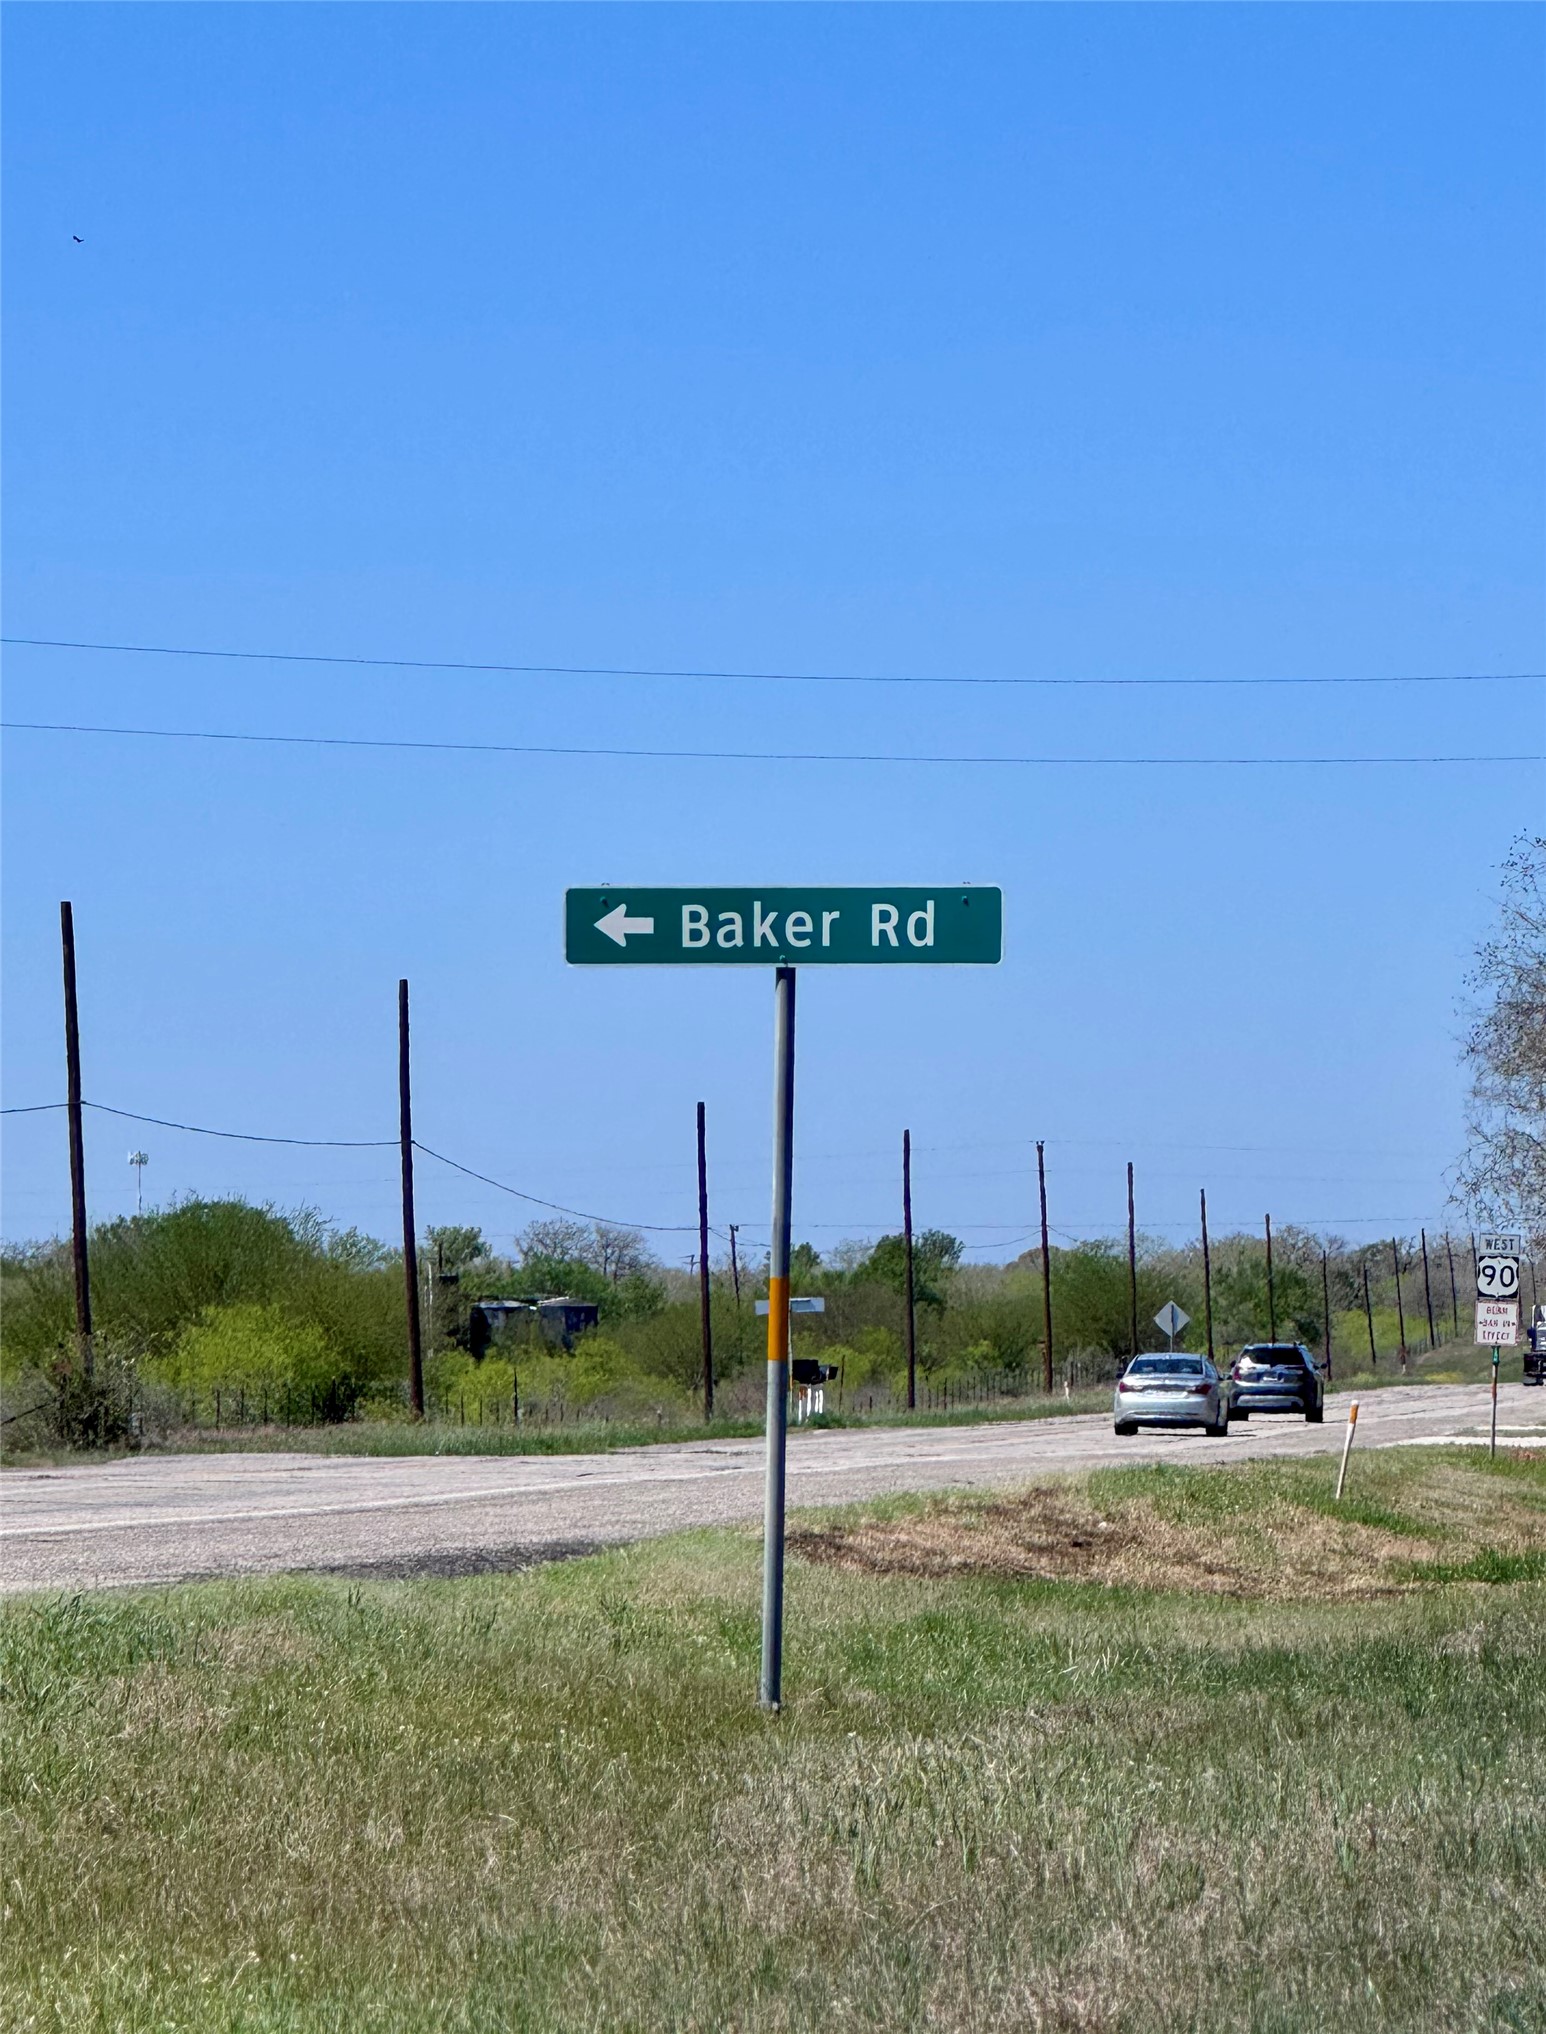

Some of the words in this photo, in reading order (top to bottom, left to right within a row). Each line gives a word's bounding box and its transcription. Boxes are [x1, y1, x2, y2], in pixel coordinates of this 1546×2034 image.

[682, 900, 840, 948] Baker
[871, 900, 935, 947] Rd
[1486, 1239, 1514, 1251] WEST
[1482, 1265, 1514, 1287] 90
